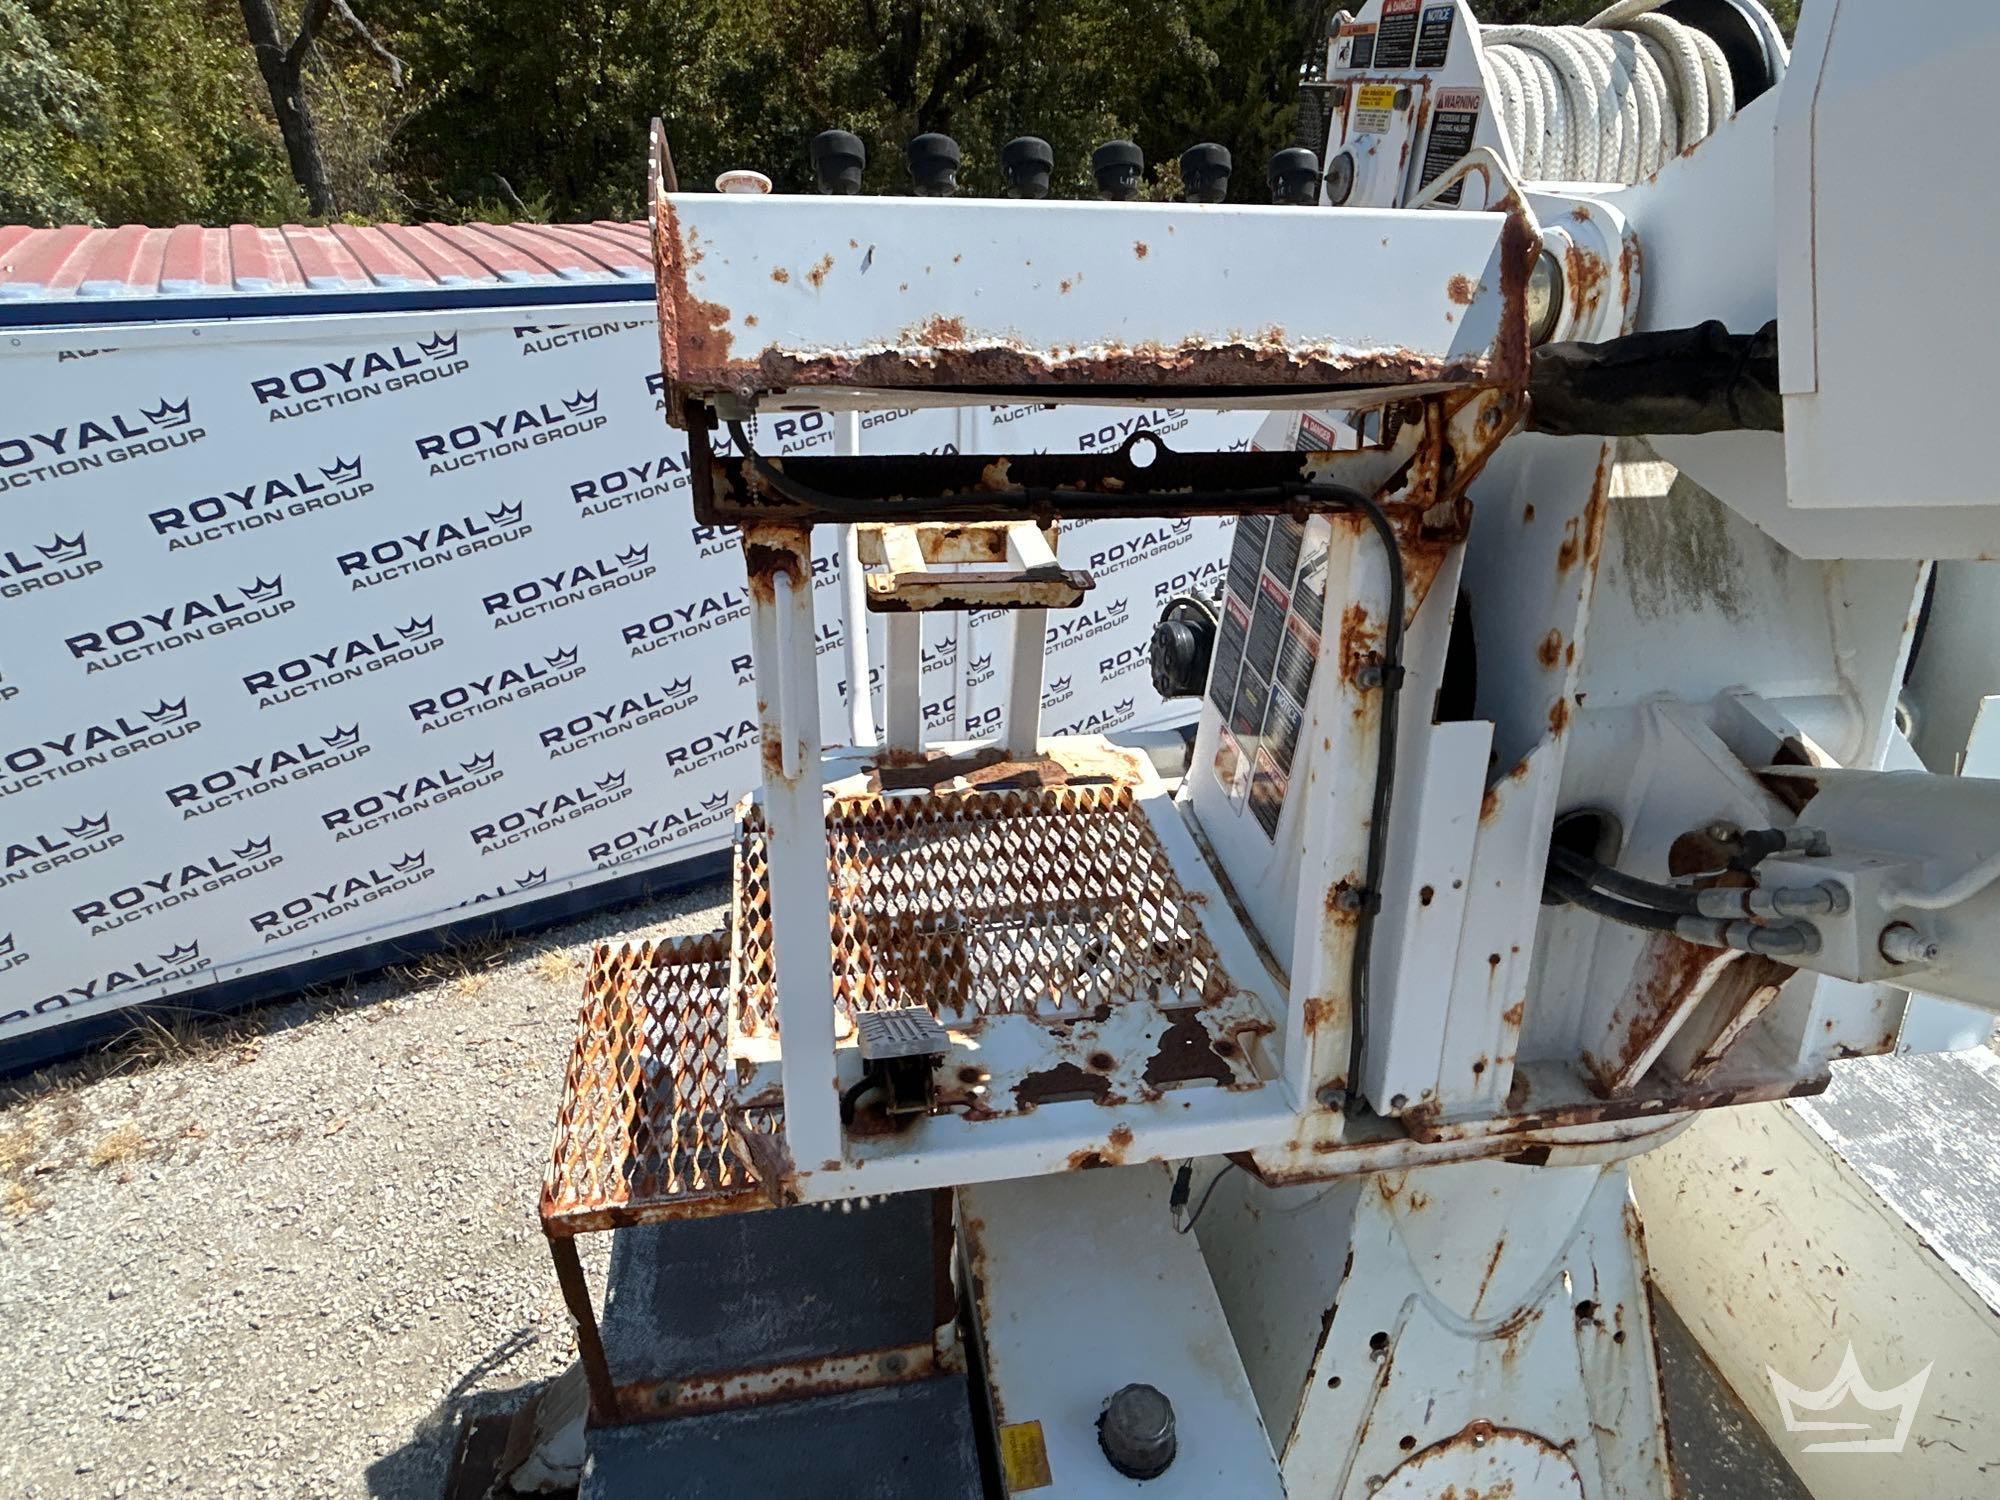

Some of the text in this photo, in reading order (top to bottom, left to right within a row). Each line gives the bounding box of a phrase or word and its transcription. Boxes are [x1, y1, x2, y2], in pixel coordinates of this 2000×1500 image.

[1427, 8, 1451, 22] NOTICE
[1443, 95, 1480, 111] WARNING
[522, 321, 620, 356] AUCTION
[251, 346, 422, 404] ROYAL
[269, 360, 470, 423] AUCTION GROUP
[107, 427, 206, 463] GROUP
[415, 403, 566, 460] ROYAL
[429, 415, 608, 477] AUCTION GROUP
[1079, 410, 1165, 451] ROYAL
[148, 472, 325, 535] ROYAL
[168, 483, 375, 552] AUCTION GROUP
[580, 483, 670, 519] AUCTION
[337, 517, 490, 576] ROYAL
[351, 525, 533, 592] AUCTION GROUP
[1090, 526, 1171, 569] ROYAL
[1093, 534, 1193, 580] AUCTION GROUP
[1, 560, 103, 598] GROUP
[482, 559, 619, 615] ROYAL
[493, 565, 657, 630] AUCTION GROUP
[1155, 558, 1229, 598] ROYAL
[64, 593, 245, 658] ROYAL
[85, 600, 296, 675] AUCTION GROUP
[621, 592, 743, 645] ROYAL
[630, 618, 712, 658] AUCTION
[1086, 614, 1129, 639] GROUP
[243, 629, 400, 694] ROYAL
[259, 637, 444, 709] AUCTION GROUP
[408, 661, 547, 721] ROYAL
[421, 666, 587, 734] AUCTION GROUP
[539, 690, 664, 747] ROYAL
[549, 694, 699, 760] AUCTION GROUP
[1275, 692, 1298, 725] NOTICE
[0, 718, 149, 780] OYAL
[111, 720, 202, 759] GROUP
[673, 738, 748, 778] AUCTION
[165, 742, 326, 808] ROYAL
[183, 744, 371, 821] AUCTION GROUP
[322, 768, 464, 830] ROYAL
[335, 770, 505, 843] AUCTION GROUP
[469, 787, 597, 844] ROYAL
[481, 788, 633, 856] AUCTION GROUP
[588, 805, 702, 862] ROYAL
[32, 834, 125, 874] GROUP
[597, 807, 734, 870] AUCTION GROUP
[72, 855, 237, 924] ROYAL
[90, 855, 284, 937] AUCTION GROUP
[250, 870, 393, 932] ROYAL
[264, 899, 359, 943] AUCTION
[363, 868, 435, 902] GROUP
